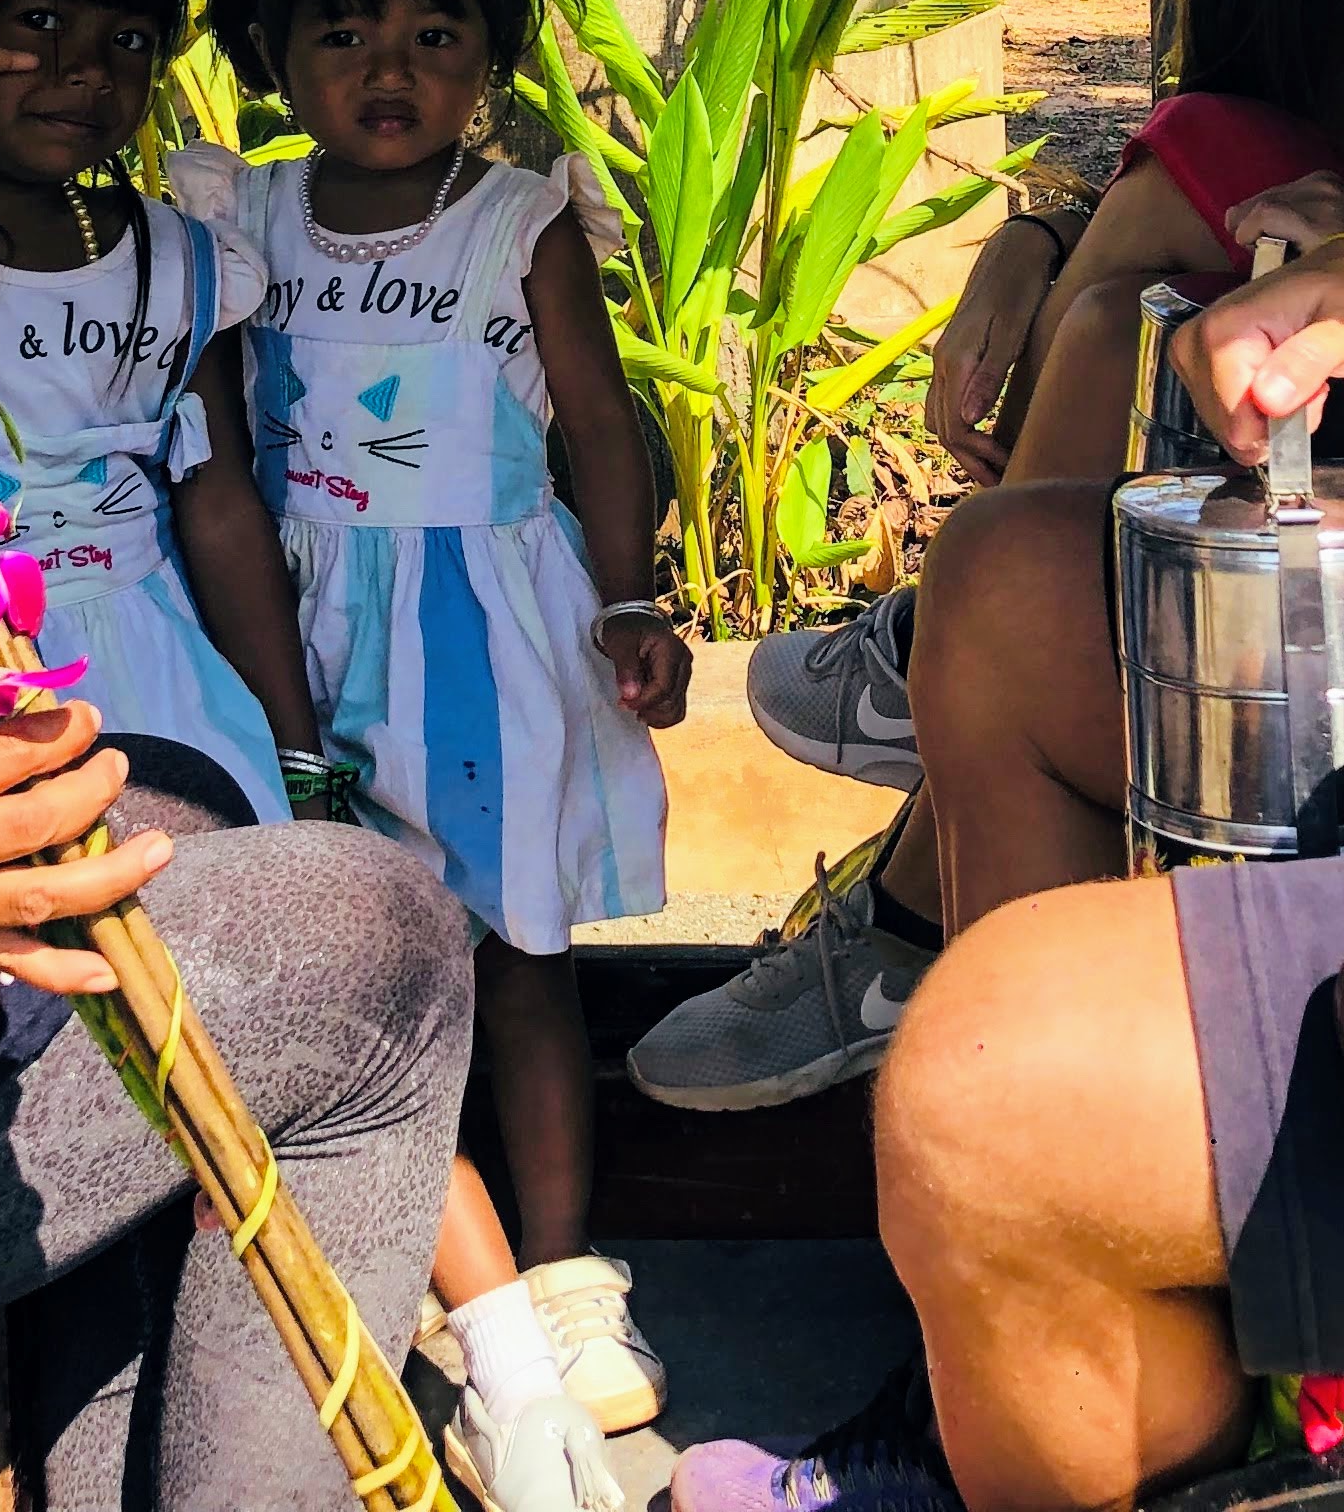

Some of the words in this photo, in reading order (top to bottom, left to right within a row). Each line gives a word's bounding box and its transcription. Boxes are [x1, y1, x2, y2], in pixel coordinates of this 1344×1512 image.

[317, 276, 345, 312] &
[361, 261, 459, 324] love
[19, 324, 48, 360] &
[63, 301, 159, 364] love
[325, 476, 370, 512] Stay
[67, 544, 113, 571] Stay
